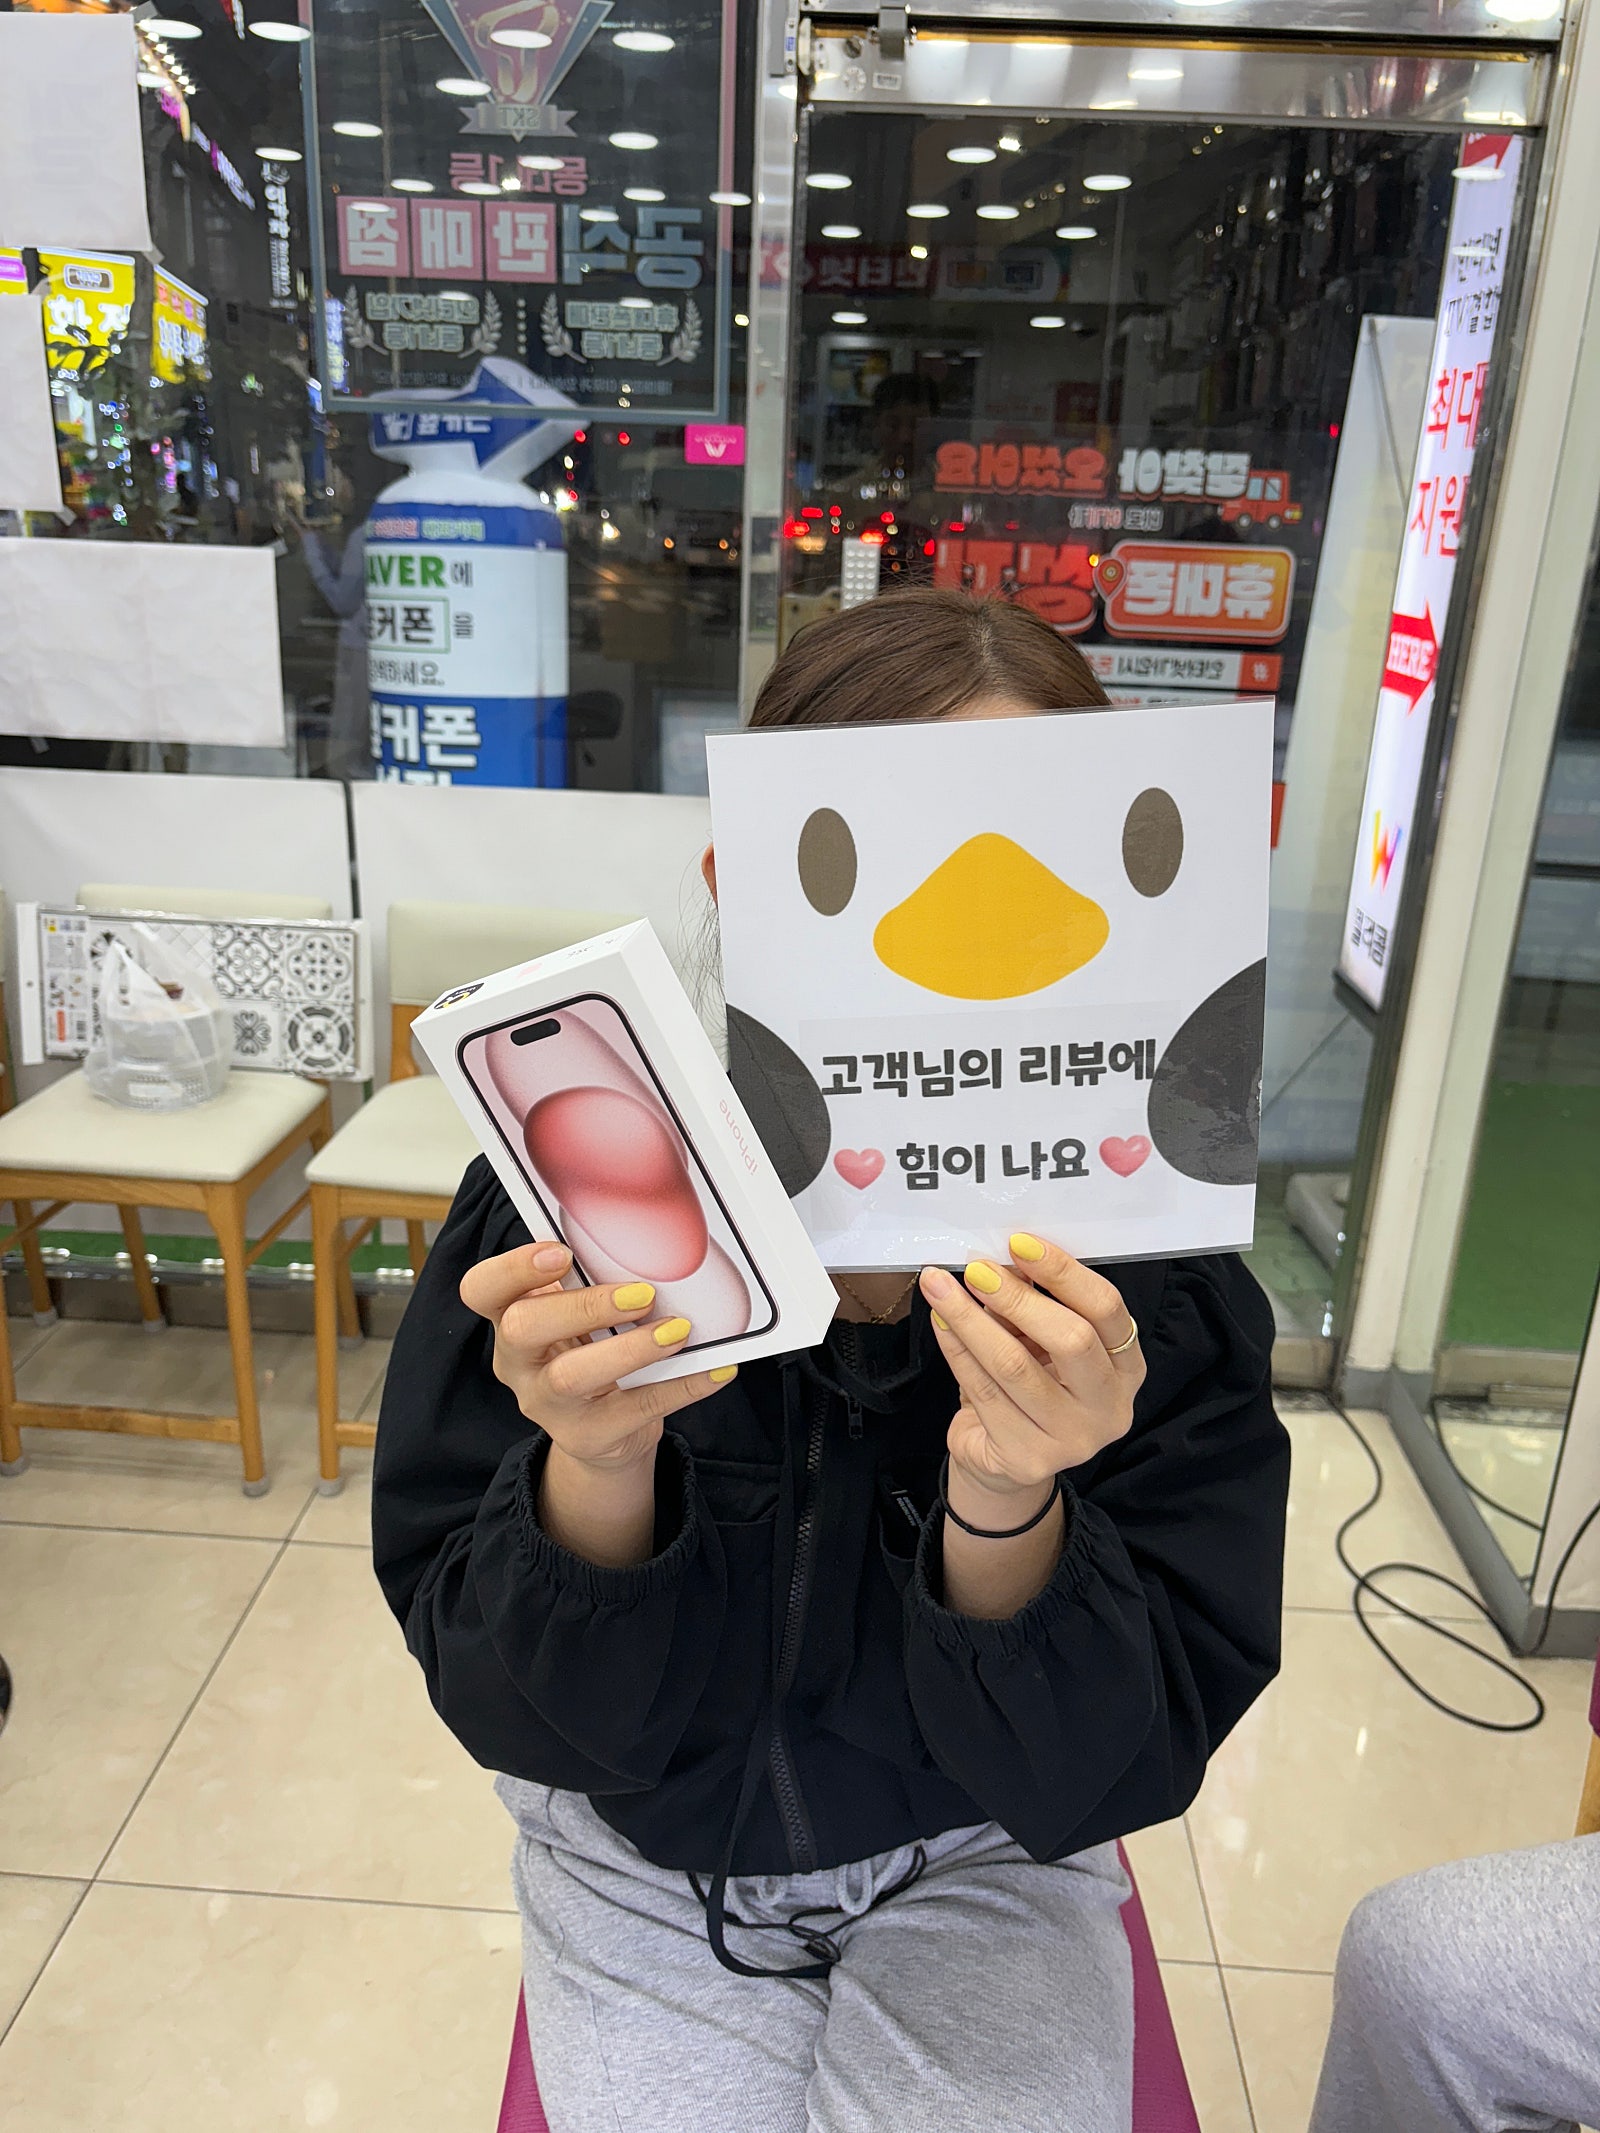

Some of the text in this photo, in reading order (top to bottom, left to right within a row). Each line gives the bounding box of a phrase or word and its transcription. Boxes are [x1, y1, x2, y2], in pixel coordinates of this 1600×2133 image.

[1427, 361, 1489, 450] 최대
[1410, 474, 1470, 558] 지원
[1386, 631, 1435, 682] HERE
[822, 1038, 1156, 1098] 고객님의 리뷰에
[719, 1099, 758, 1176] iPhone
[896, 1138, 1089, 1190] 힘이 나요
